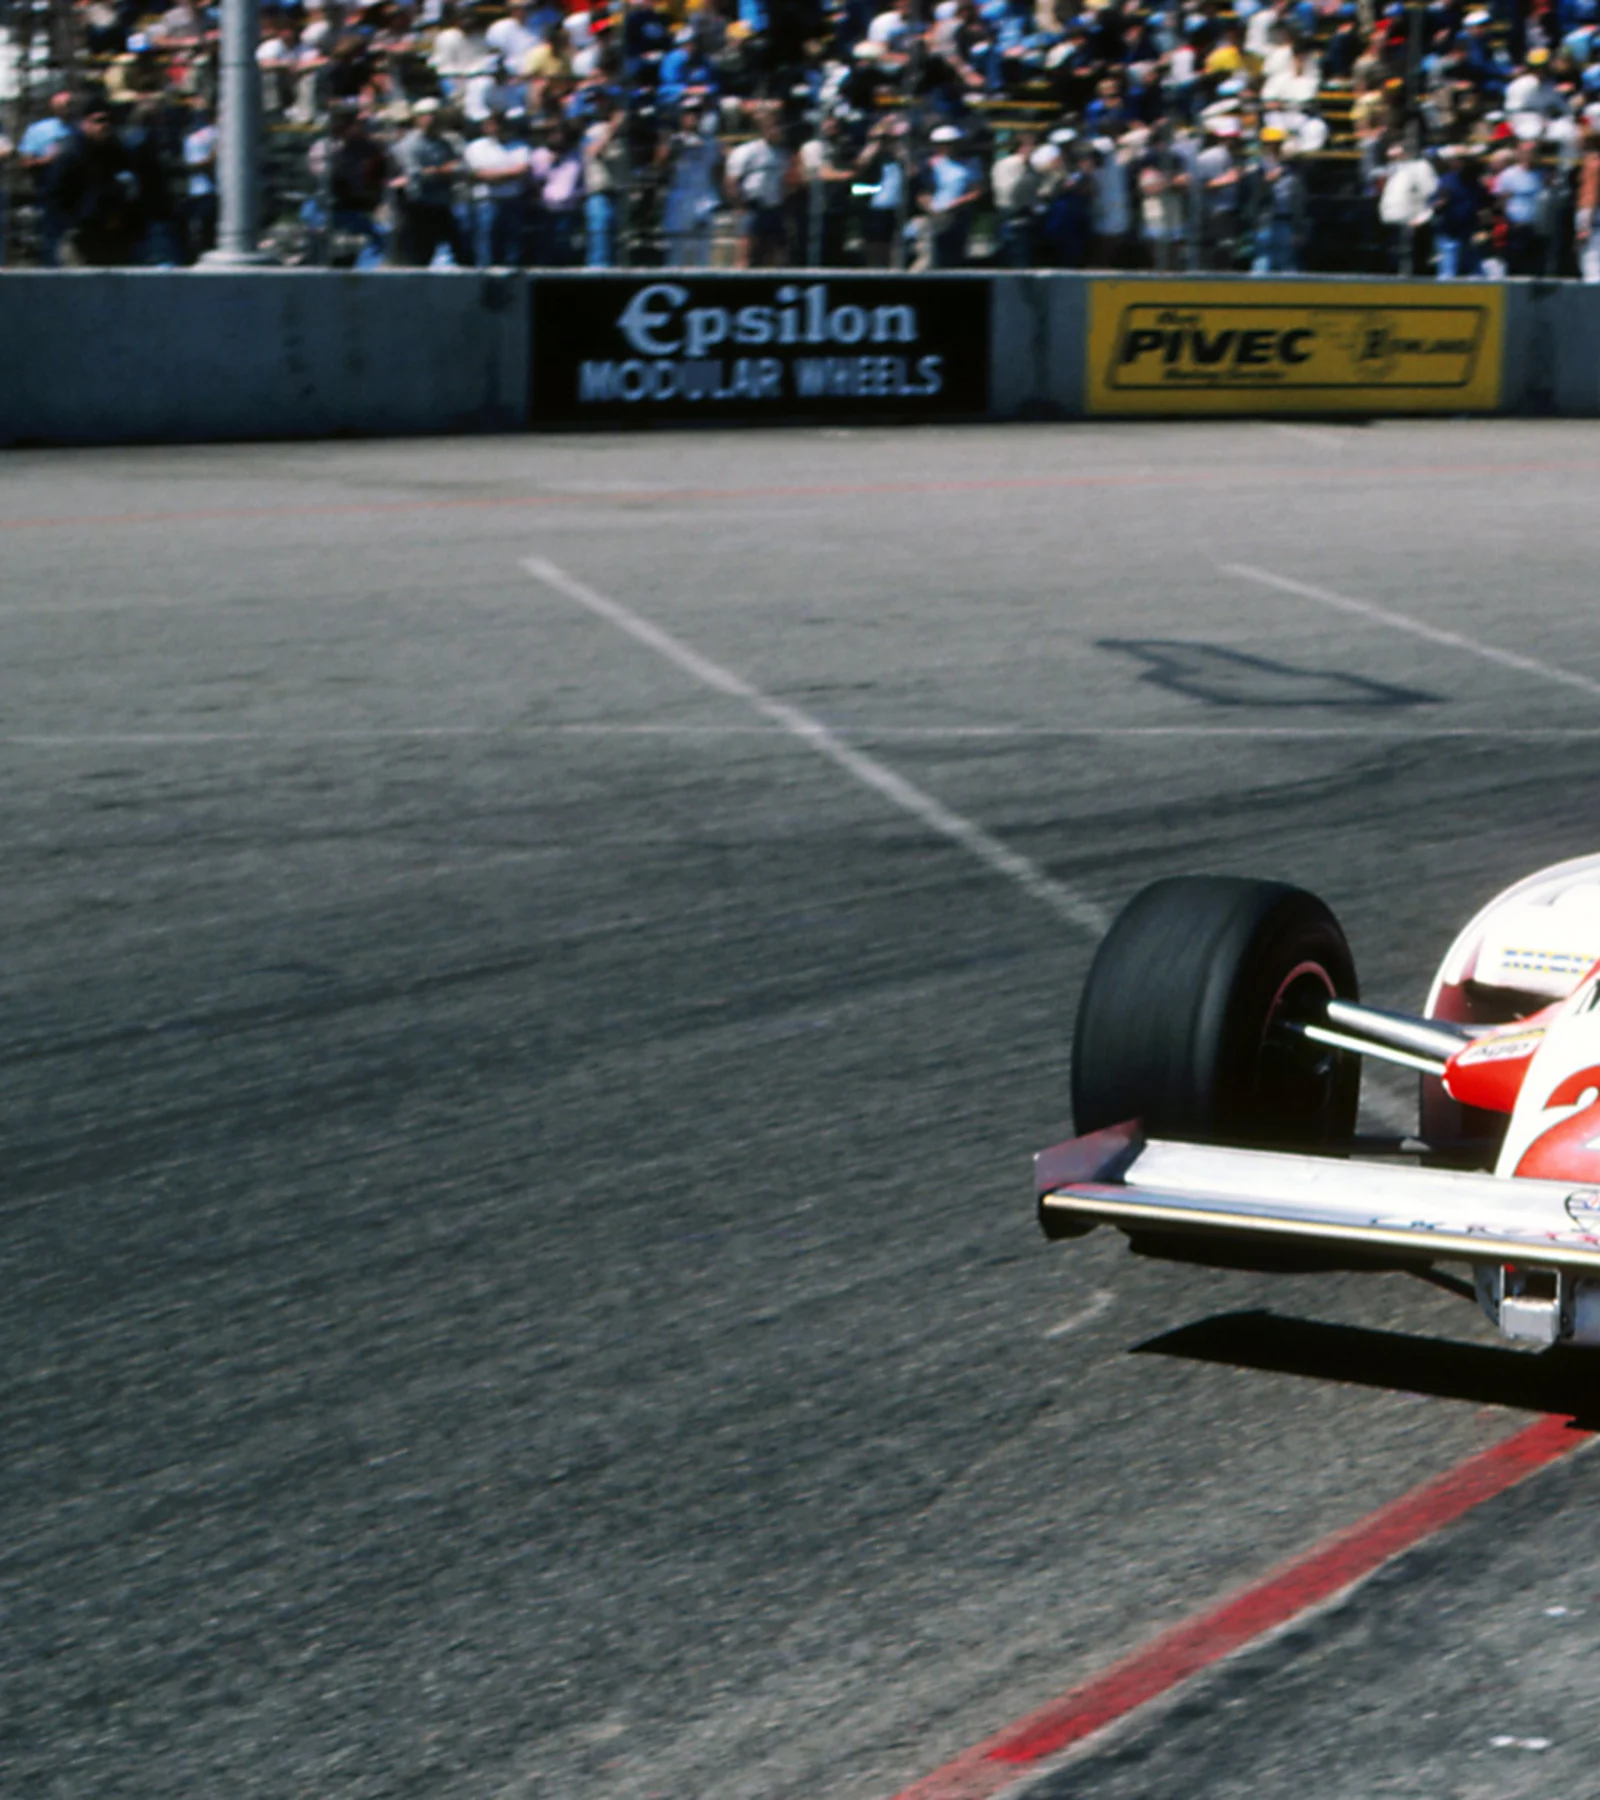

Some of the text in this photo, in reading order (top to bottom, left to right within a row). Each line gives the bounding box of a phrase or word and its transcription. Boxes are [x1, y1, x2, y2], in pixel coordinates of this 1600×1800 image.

[616, 283, 918, 355] Epsilon
[1120, 328, 1317, 365] PIVEC
[579, 355, 944, 401] MODULAR WHEELS
